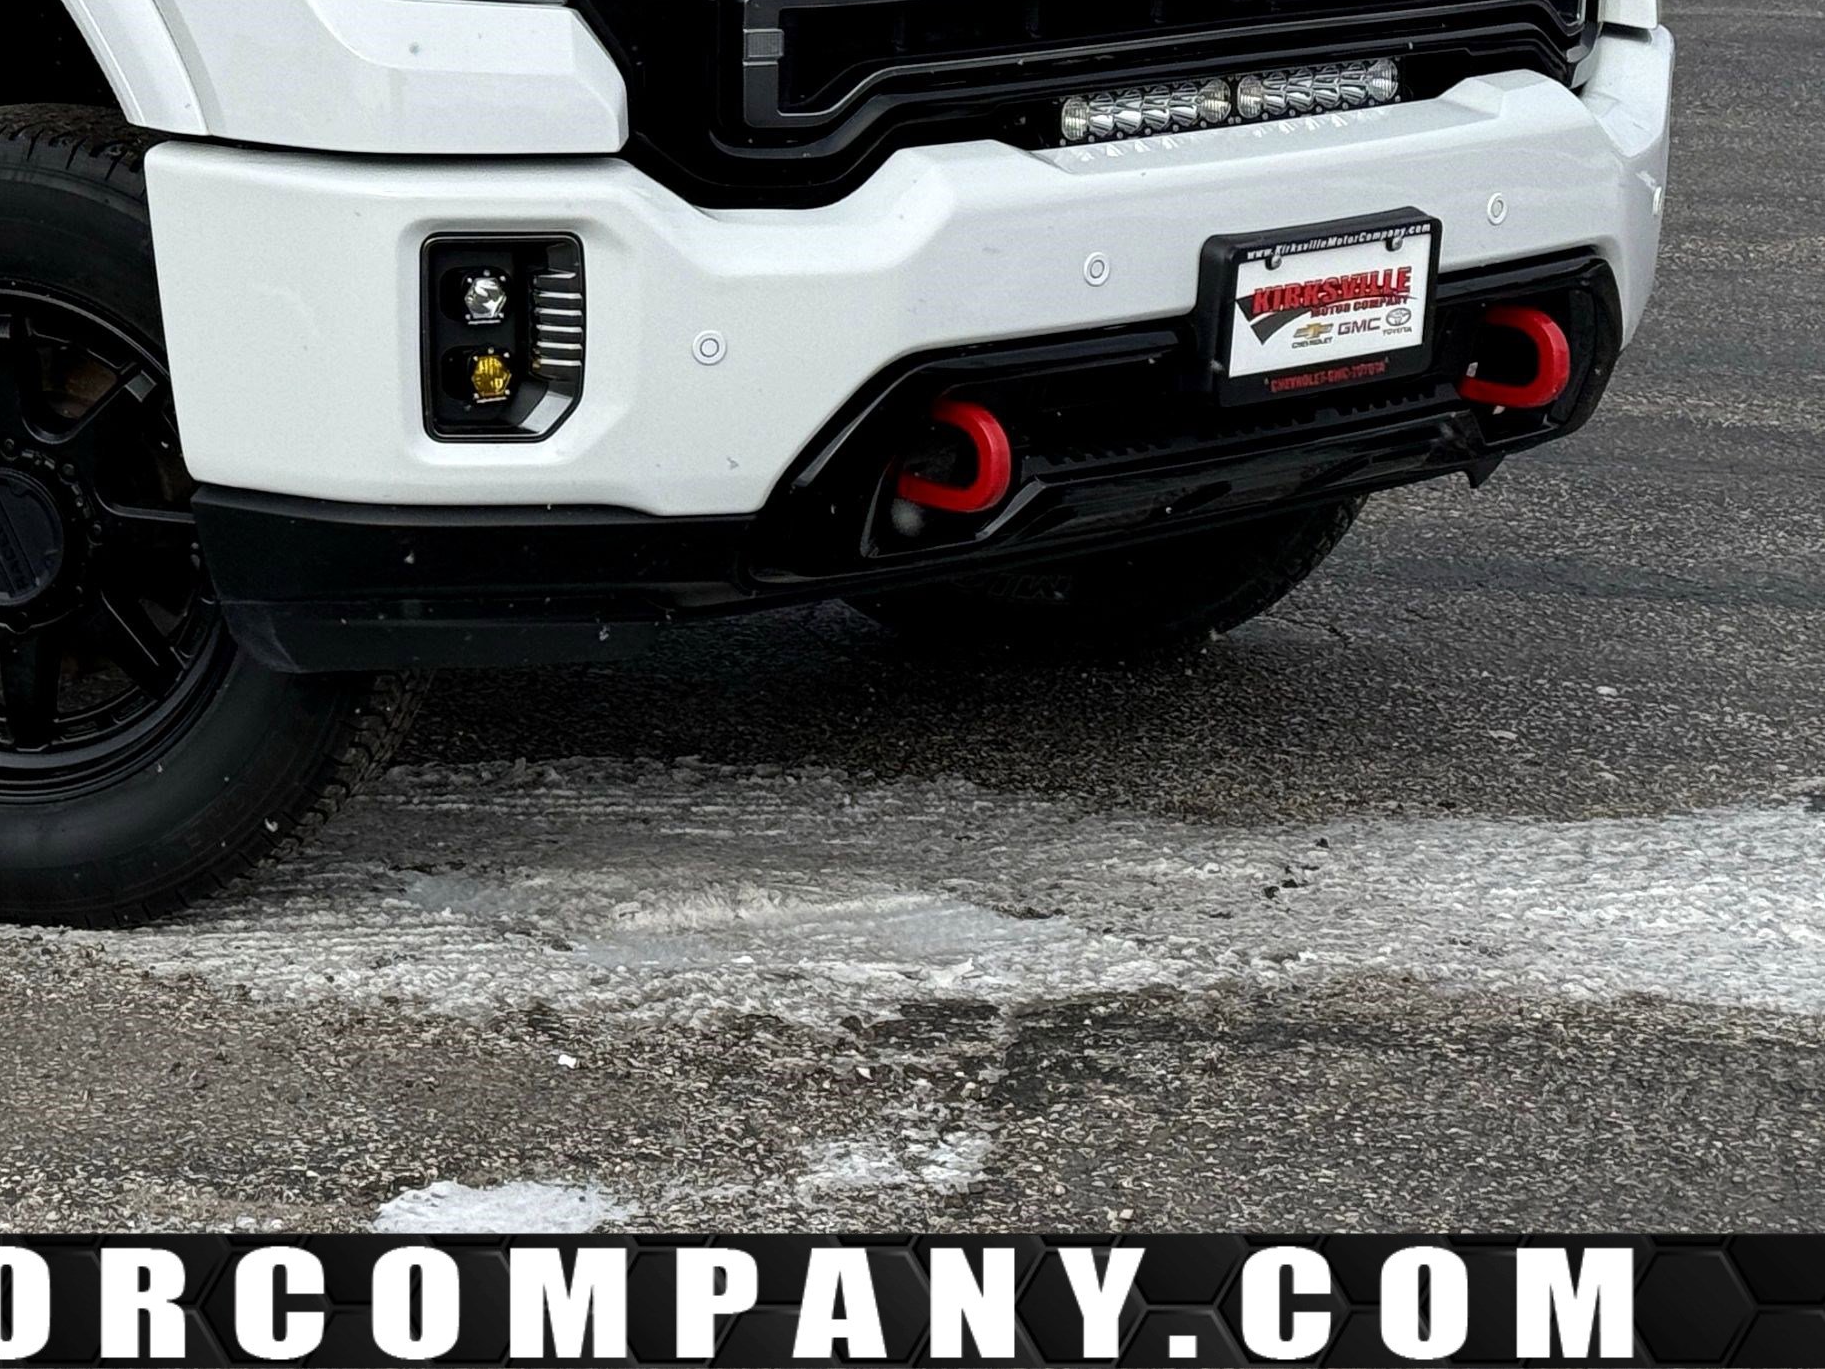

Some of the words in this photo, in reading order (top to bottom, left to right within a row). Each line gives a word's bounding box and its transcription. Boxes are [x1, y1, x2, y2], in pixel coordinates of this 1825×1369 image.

[1253, 266, 1413, 316] KIRKSVILLE
[1310, 302, 1351, 318] MOTOR
[1354, 296, 1408, 312] COMPANY
[1291, 337, 1333, 349] CHEVROLET
[1338, 317, 1381, 336] GMC
[1382, 326, 1413, 337] TOYOTA
